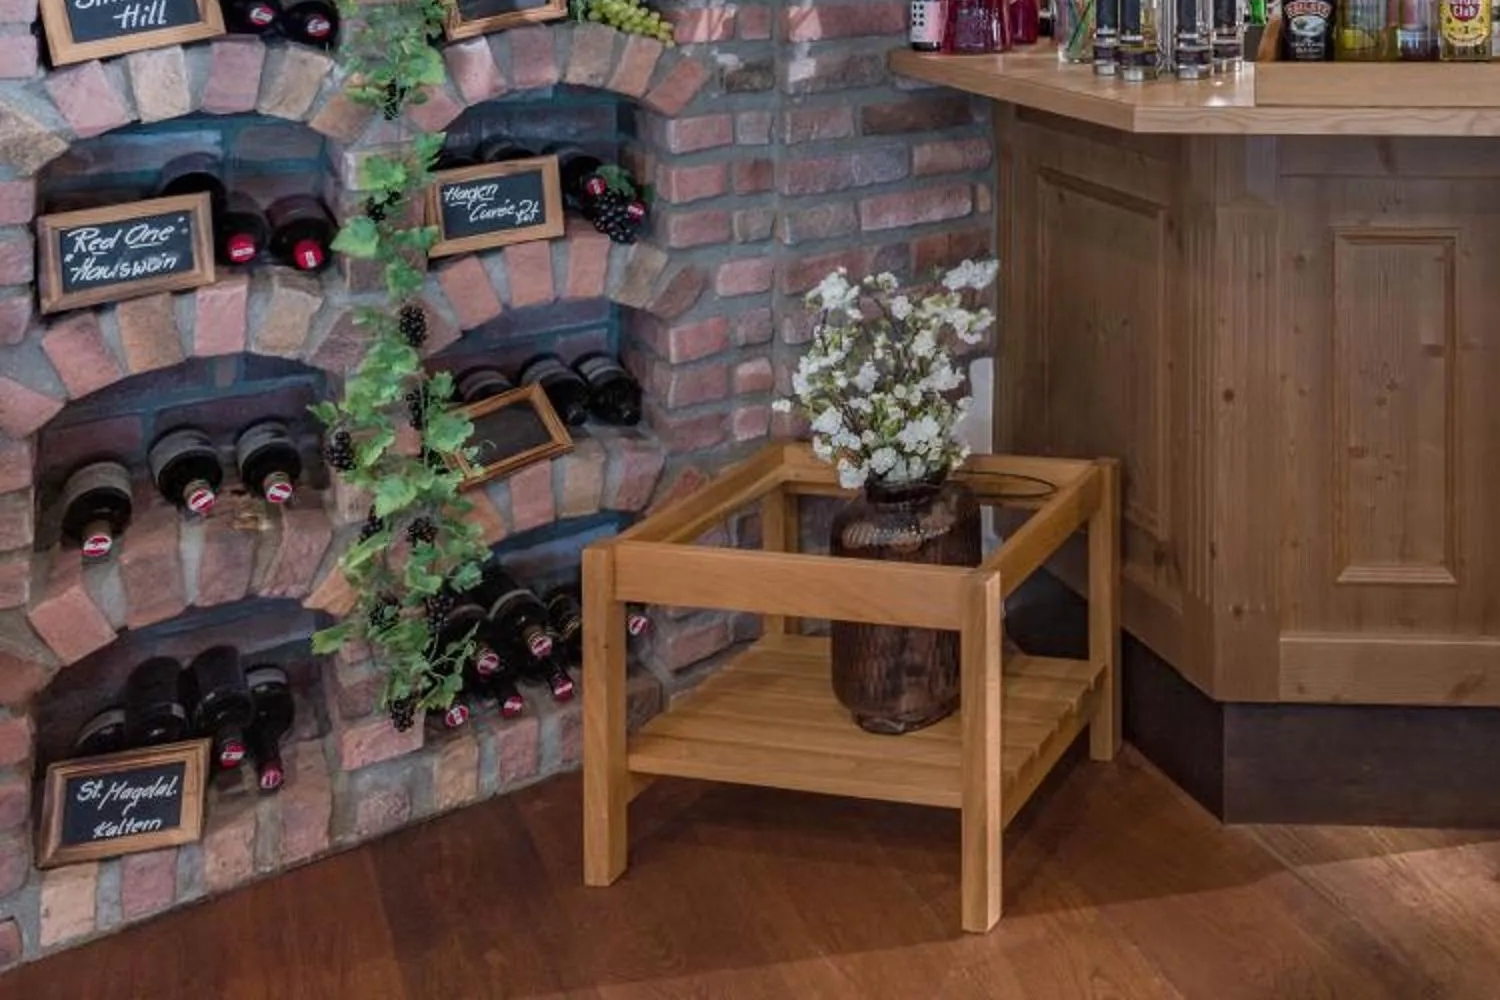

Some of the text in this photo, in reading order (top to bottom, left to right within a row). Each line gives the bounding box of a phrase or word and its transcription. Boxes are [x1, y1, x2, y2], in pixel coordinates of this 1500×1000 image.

[113, 0, 167, 29] Hill
[67, 223, 176, 255] Red One
[77, 780, 103, 802] St.
